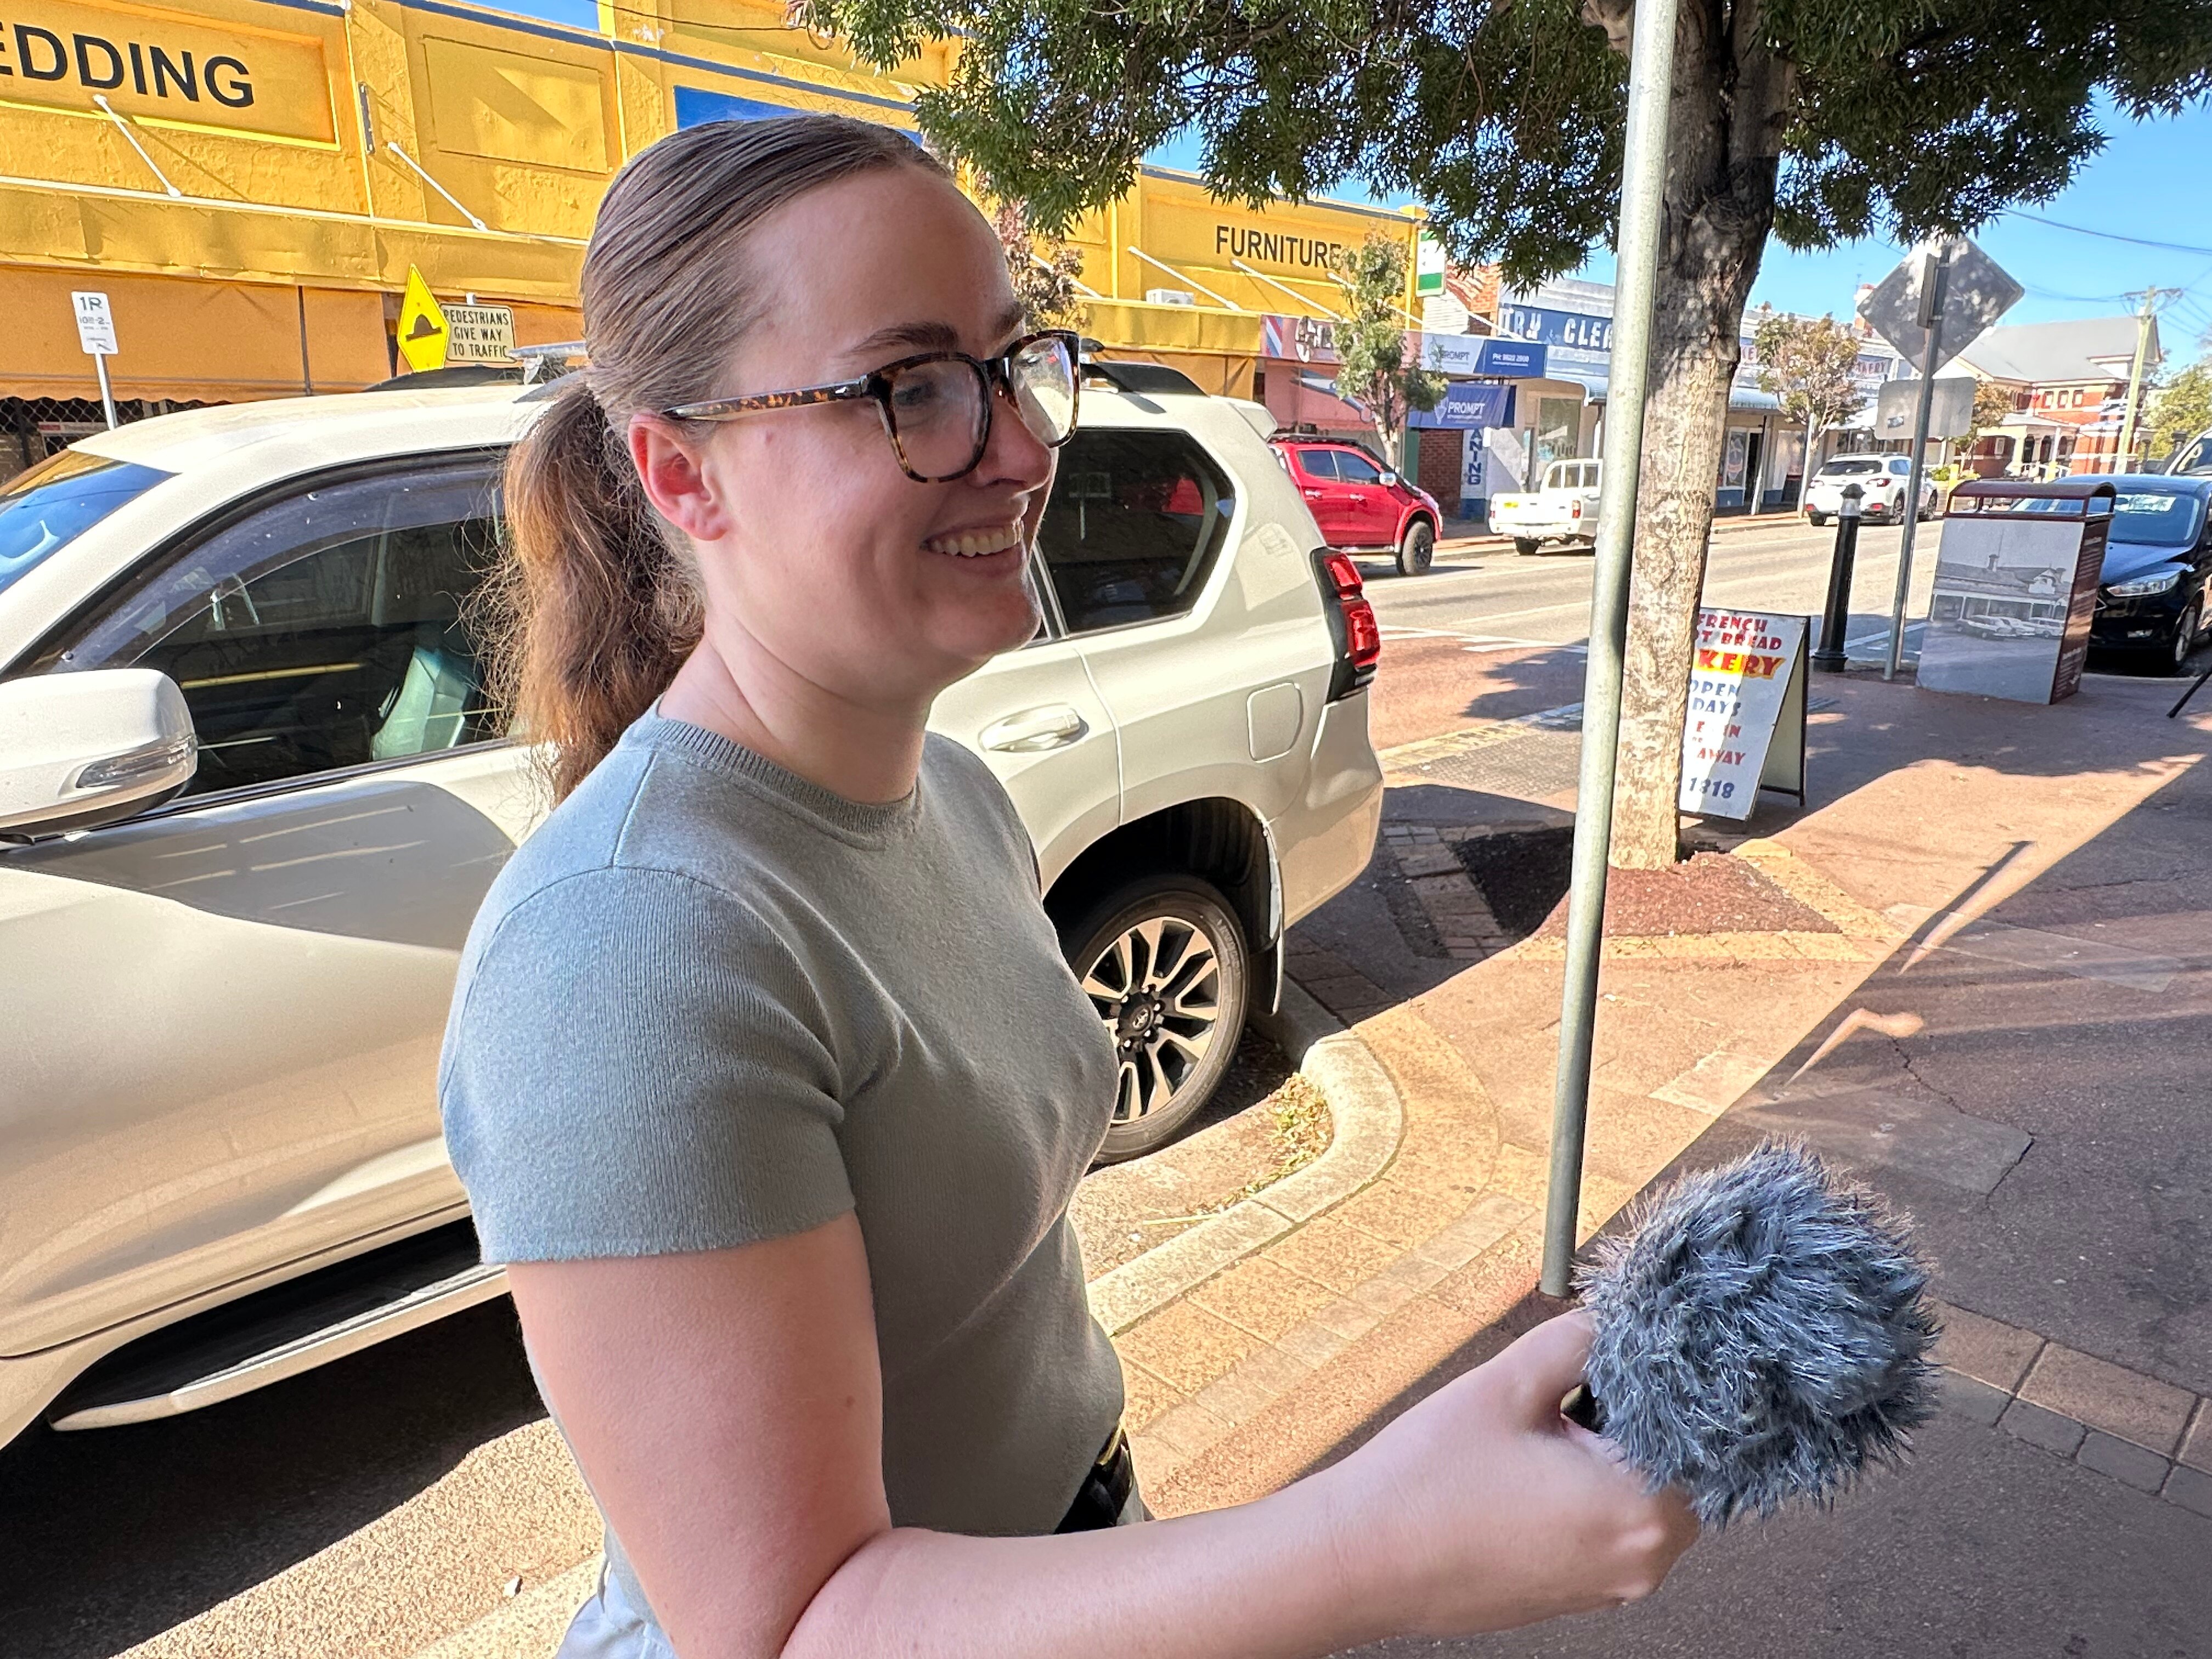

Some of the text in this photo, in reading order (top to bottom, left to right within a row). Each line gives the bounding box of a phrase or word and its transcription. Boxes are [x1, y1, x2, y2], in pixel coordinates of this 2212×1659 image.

[443, 309, 509, 326] PEDESTRIANS
[454, 326, 502, 342] GIVE WAY
[452, 342, 507, 358] TO TRAFFIC
[1447, 401, 1486, 415] PROMPT
[1720, 632, 1782, 650] BREAD
[1692, 697, 1741, 716] DAYS
[1697, 747, 1747, 765] AWAY
